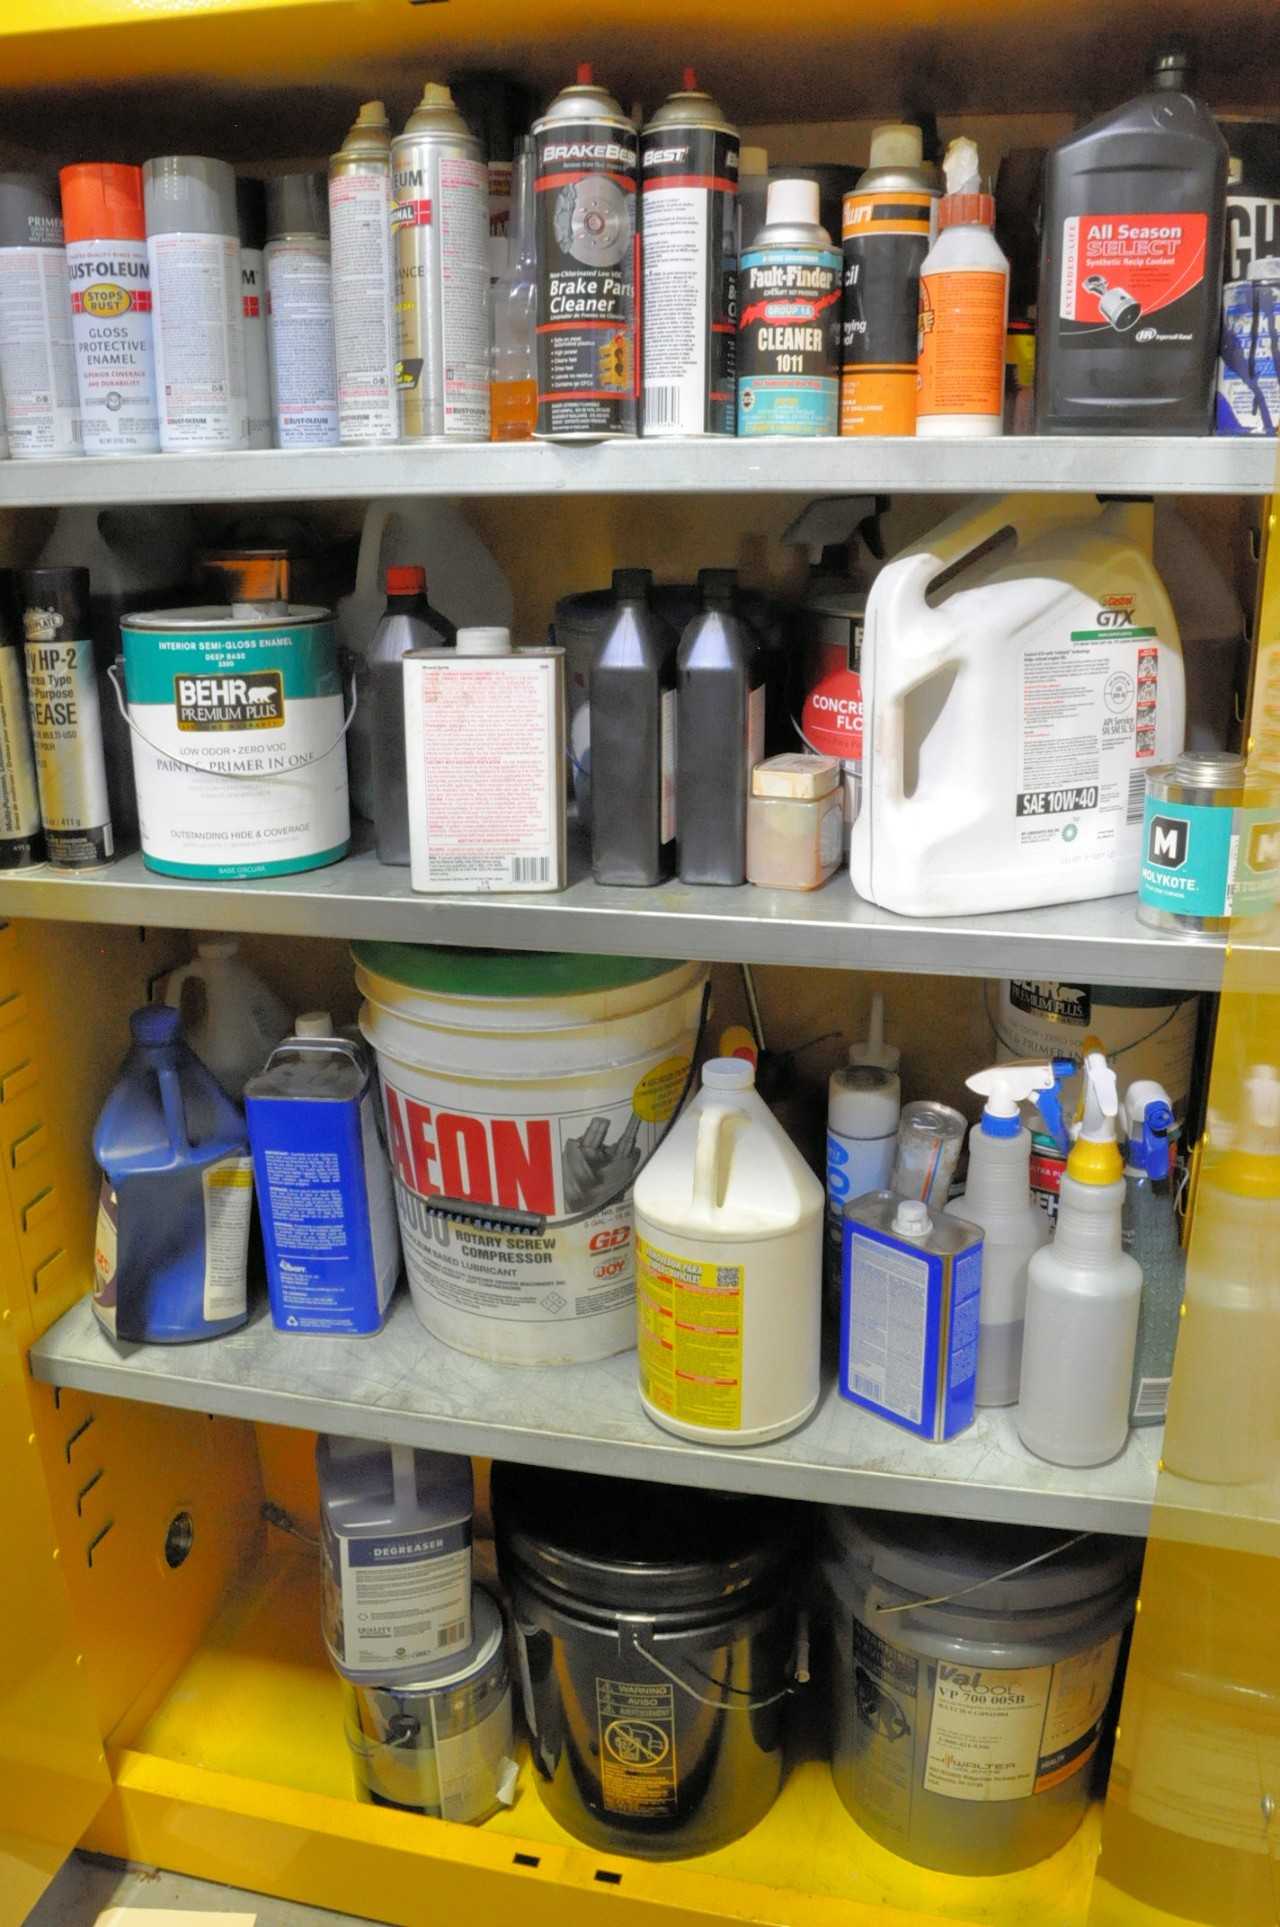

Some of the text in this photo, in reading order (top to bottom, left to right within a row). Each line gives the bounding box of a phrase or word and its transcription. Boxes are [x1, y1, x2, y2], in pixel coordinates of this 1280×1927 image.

[1087, 224, 1182, 240] All Season
[1086, 239, 1181, 257] SELECT
[550, 278, 597, 297] Brake
[750, 266, 833, 290] Fault-Finder
[87, 291, 123, 301] STOPS
[90, 301, 120, 310] RUST
[550, 295, 616, 314] Cleaner
[88, 327, 129, 338] GLOSS
[758, 327, 823, 353] CLEANER
[78, 340, 147, 352] PROTECTIVE
[87, 353, 137, 366] ENAMEL
[776, 354, 803, 373] 1011
[1096, 608, 1136, 628] GTX
[158, 636, 293, 651] INTERIOR SEMI-GLOSS ENAMEL
[38, 647, 78, 672] HP-2
[178, 679, 248, 707] BEHR
[181, 703, 278, 722] PREMIUM PLUS
[180, 745, 200, 756] LOW
[201, 745, 231, 755] ODOR
[238, 744, 265, 755] ZERO
[268, 756, 285, 769] IN
[1022, 787, 1096, 815] SAE 10W-40
[171, 822, 311, 841] OUTSTANDING HIDE & COVERAGE
[1152, 825, 1179, 860] M
[1055, 1000, 1084, 1017] PLUS
[384, 1081, 556, 1216] AEON
[455, 1230, 557, 1251] ROTARY SCREW
[433, 1250, 460, 1267] BASED
[461, 1261, 518, 1278] LUBRICANT
[461, 1245, 553, 1264] COMPRESSOR
[595, 1259, 626, 1279] JOY
[373, 1538, 445, 1557] DEGREASER
[961, 1692, 988, 1705] 700
[990, 1694, 1027, 1706] 005B
